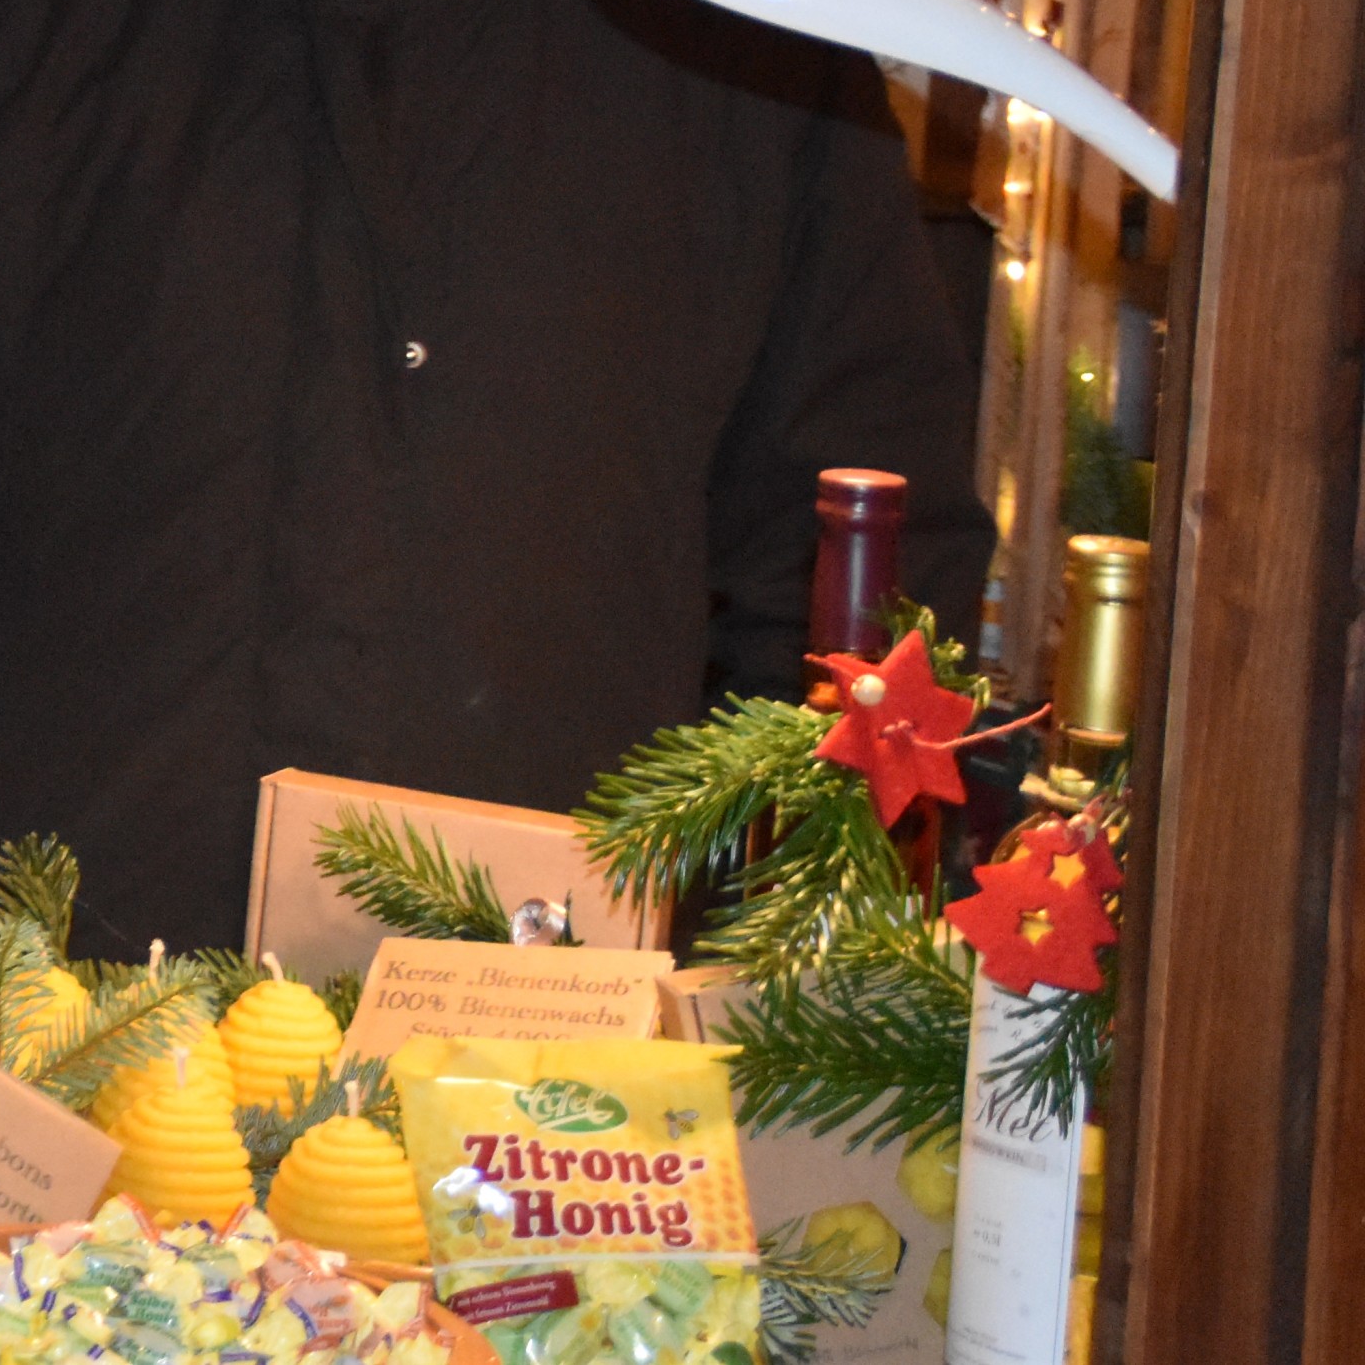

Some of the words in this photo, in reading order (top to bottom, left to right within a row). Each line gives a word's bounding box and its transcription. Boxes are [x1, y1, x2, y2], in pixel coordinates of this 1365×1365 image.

[382, 960, 457, 985] Kerze
[375, 989, 447, 1014] 100%
[458, 995, 627, 1028] Bienenwachs
[463, 1133, 706, 1186] Zitrone-
[509, 1189, 694, 1248] Honig
